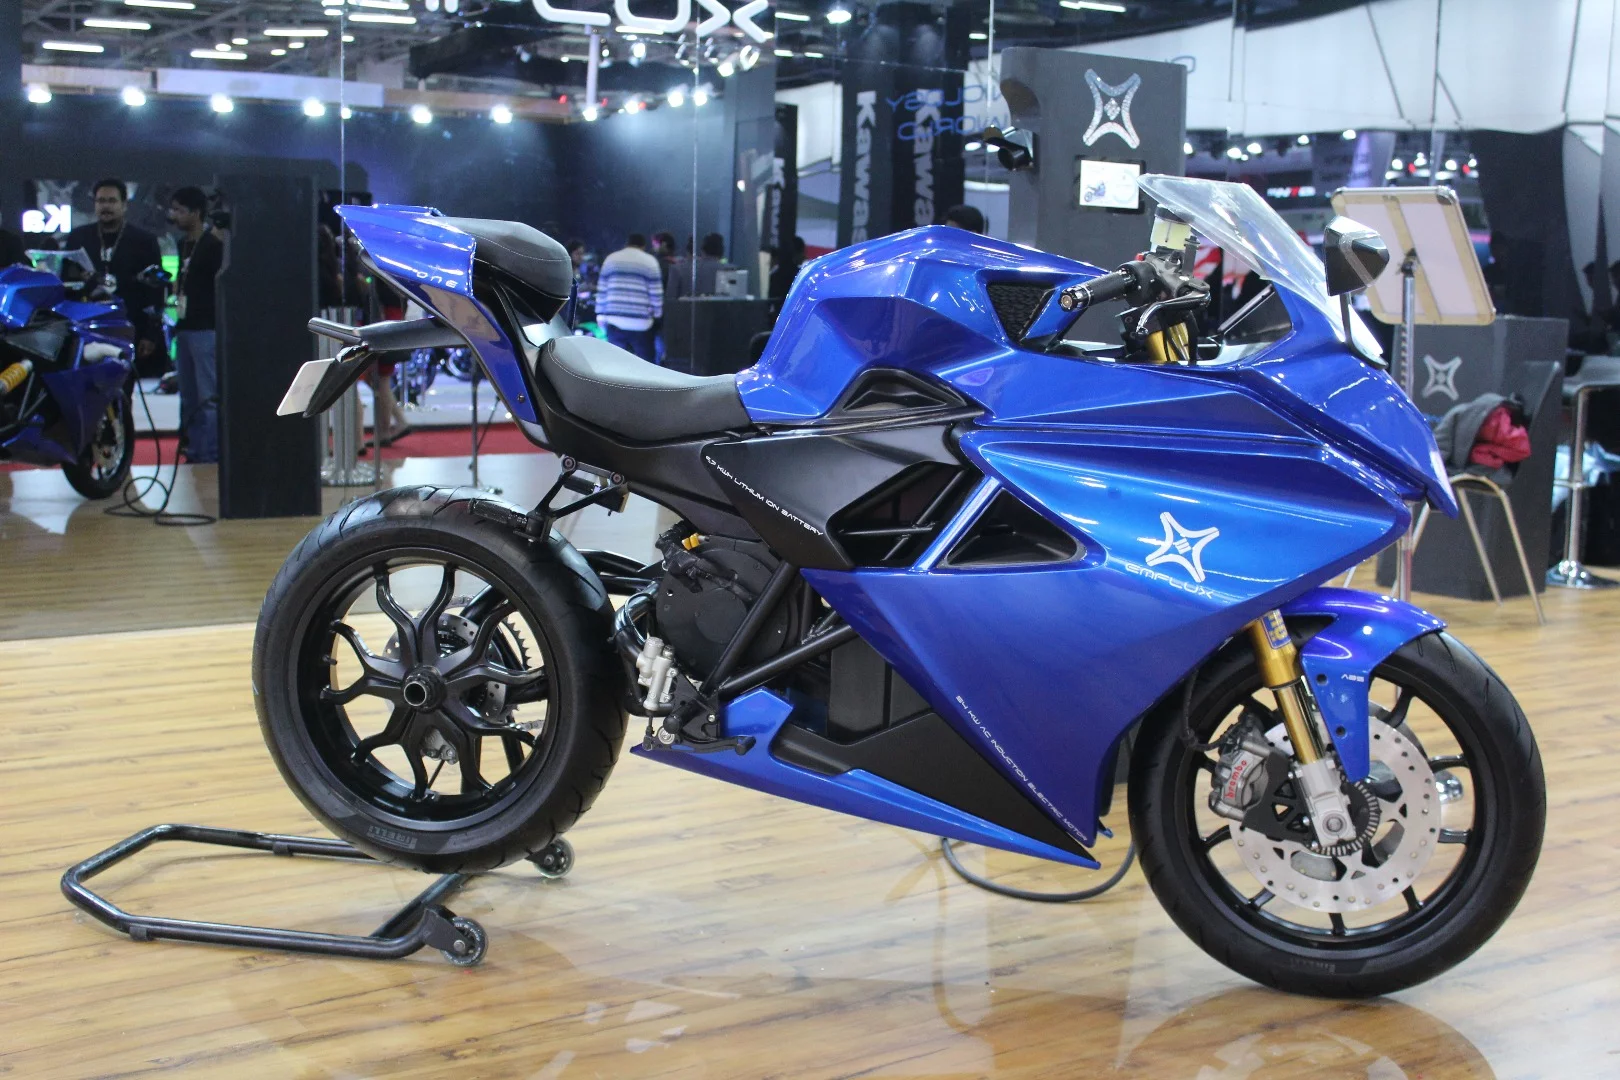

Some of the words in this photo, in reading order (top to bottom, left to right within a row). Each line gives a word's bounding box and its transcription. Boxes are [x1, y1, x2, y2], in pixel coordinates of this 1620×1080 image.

[734, 478, 764, 501] LITHIUM
[766, 499, 780, 511] ION
[781, 509, 823, 535] BATTERY
[1125, 562, 1214, 599] EMFLUX
[1341, 674, 1364, 682] ABS
[968, 711, 980, 724] KW
[979, 726, 992, 738] AC
[990, 739, 1028, 782] INDUCTION
[1027, 782, 1064, 818] ELECTRIC
[1062, 818, 1088, 841] MOTOR
[1223, 759, 1247, 799] brembo
